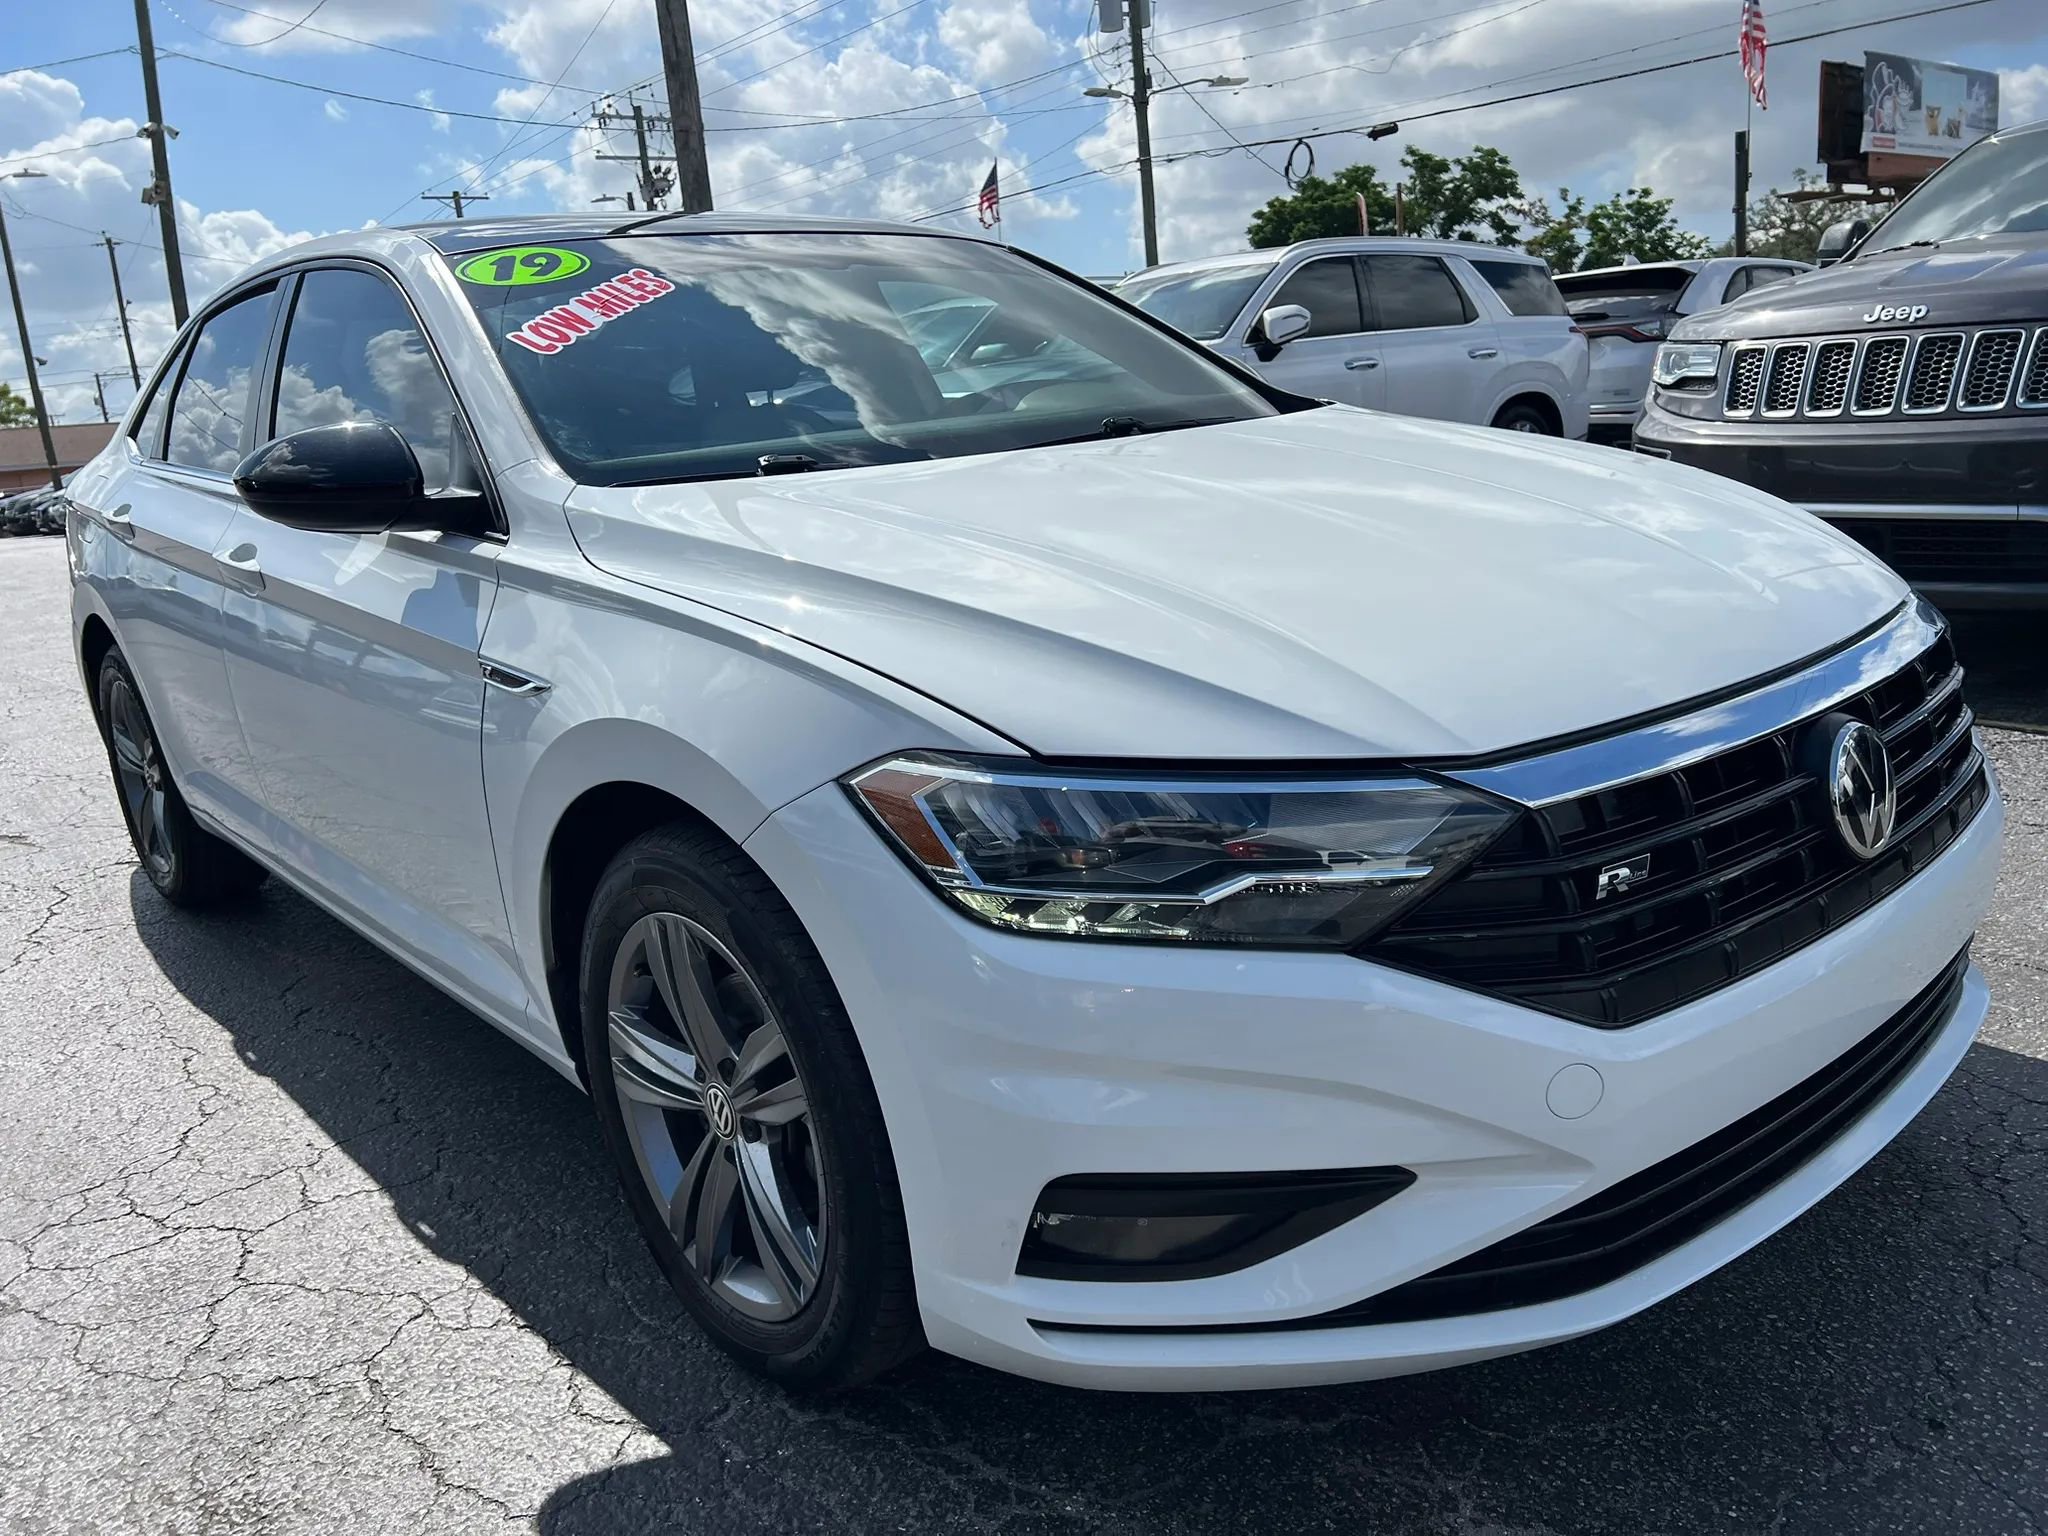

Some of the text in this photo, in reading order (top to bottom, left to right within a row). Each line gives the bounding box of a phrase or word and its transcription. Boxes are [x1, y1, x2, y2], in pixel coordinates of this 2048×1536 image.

[488, 251, 563, 282] 19
[512, 269, 673, 354] LOW MILES
[1863, 304, 1929, 323] Jeep
